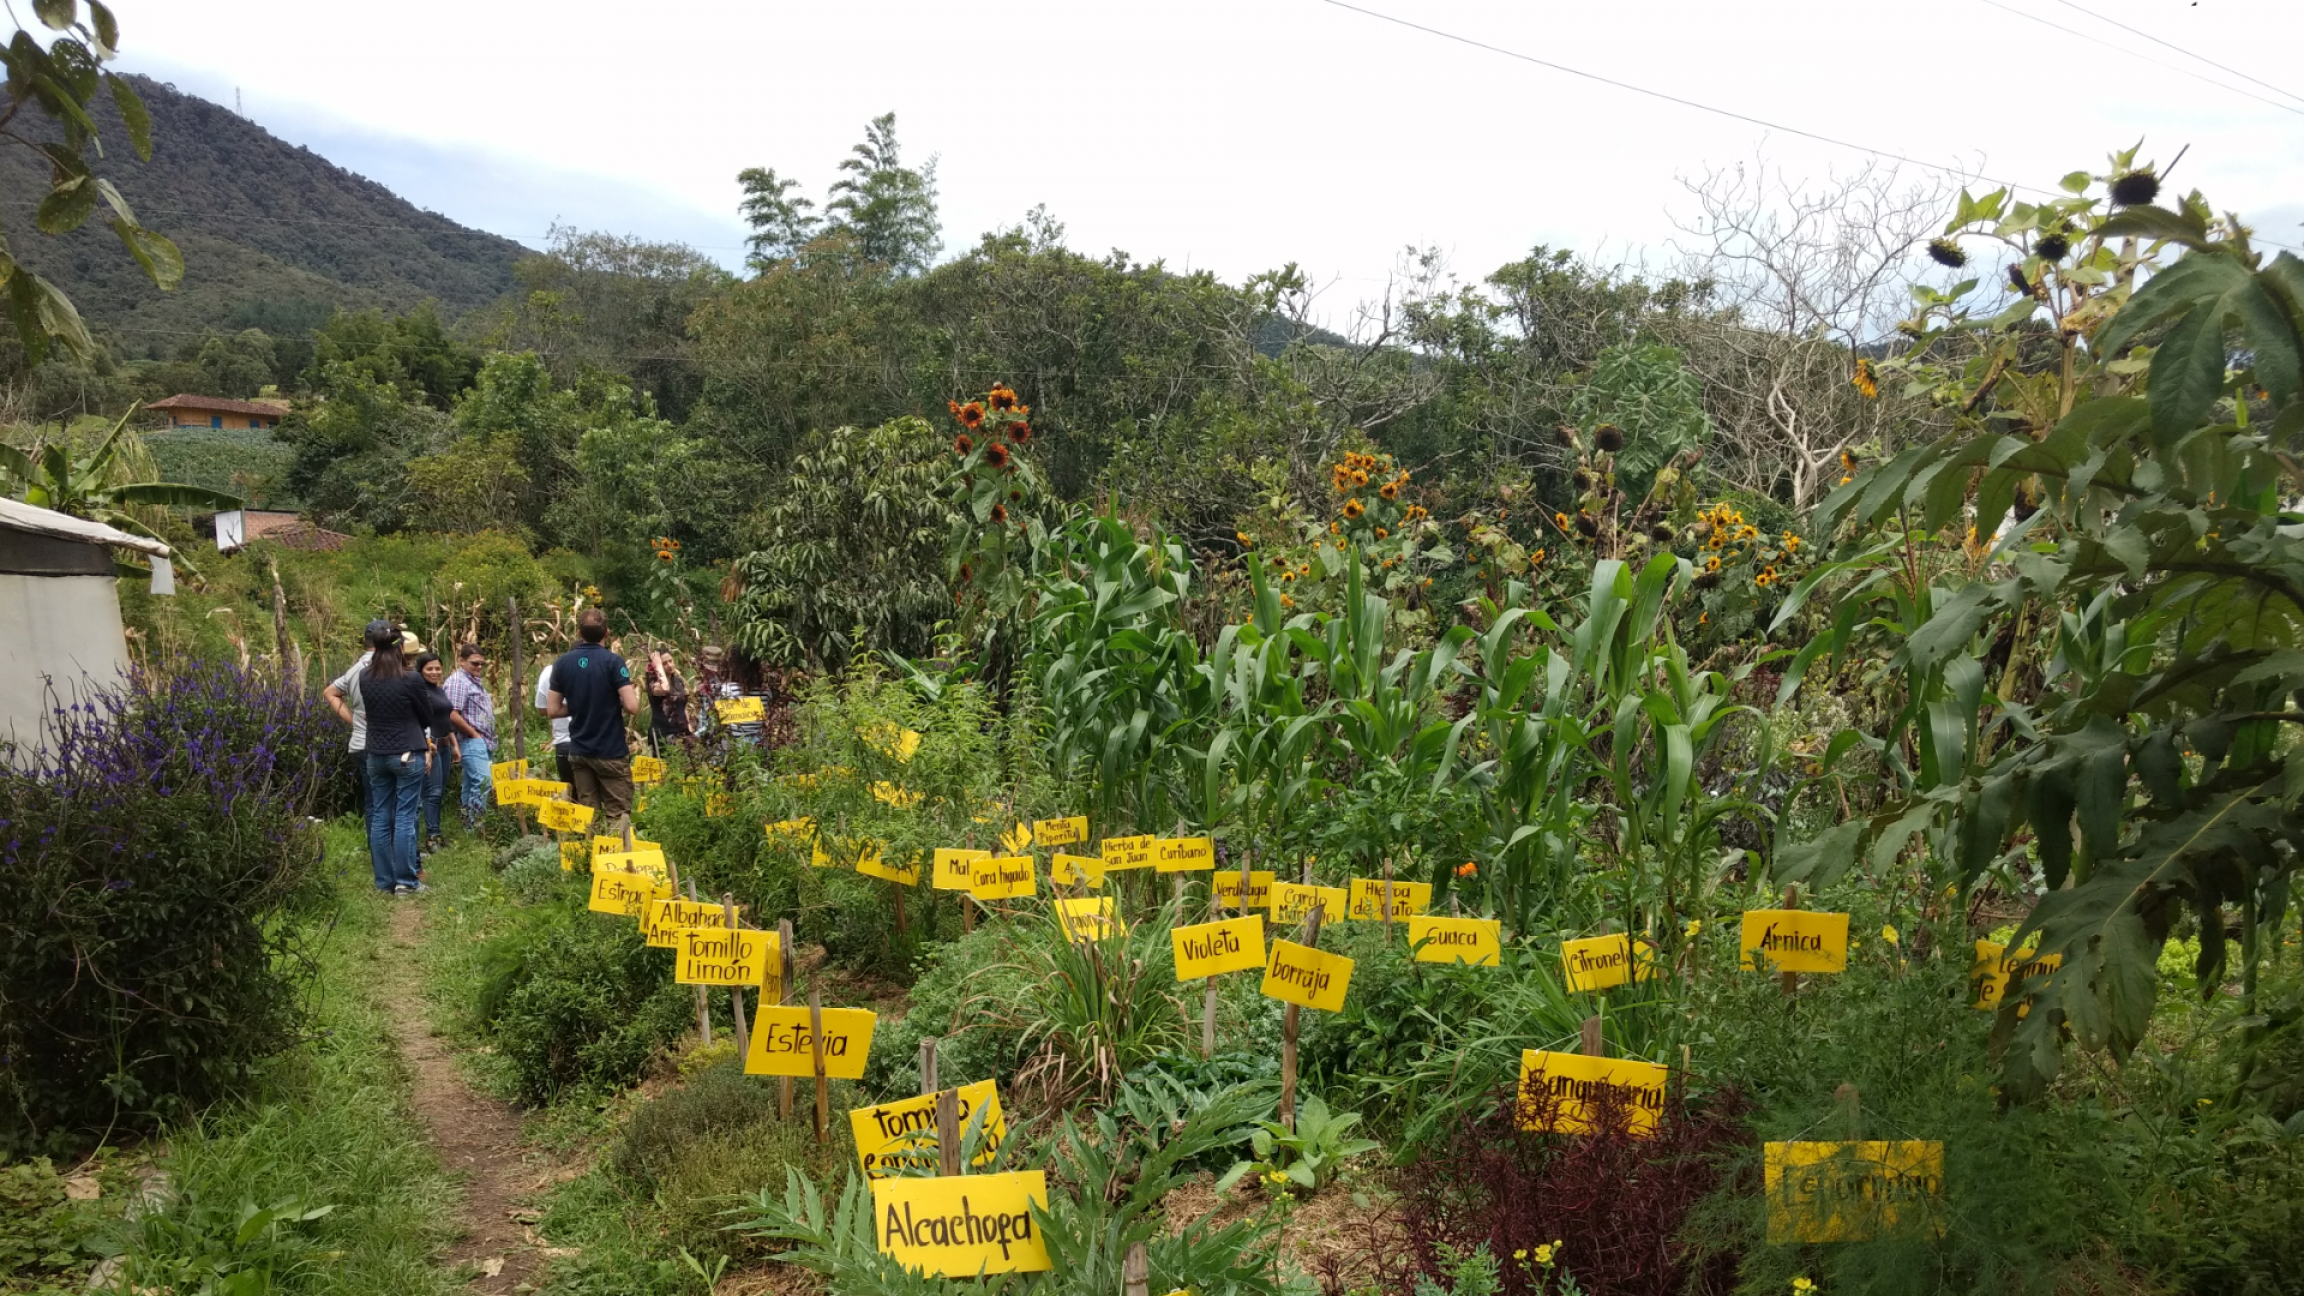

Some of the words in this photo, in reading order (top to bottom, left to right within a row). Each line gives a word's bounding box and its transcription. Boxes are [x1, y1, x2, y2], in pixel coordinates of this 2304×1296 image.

[1045, 820, 1071, 831] Menta
[1104, 838, 1134, 853] Hierba
[1140, 835, 1151, 849] de
[949, 858, 970, 876] Mal
[1105, 855, 1122, 867] San
[1126, 851, 1148, 864] Juan
[973, 870, 997, 887] Cura
[1063, 861, 1087, 881] Apo
[1283, 887, 1328, 907] Cardo
[660, 902, 738, 927] Albahac
[648, 923, 679, 945] Aris
[1426, 926, 1478, 947] Guaca
[1182, 928, 1241, 962] Violeta
[686, 958, 751, 981] Limón
[1271, 950, 1331, 1000] borraja
